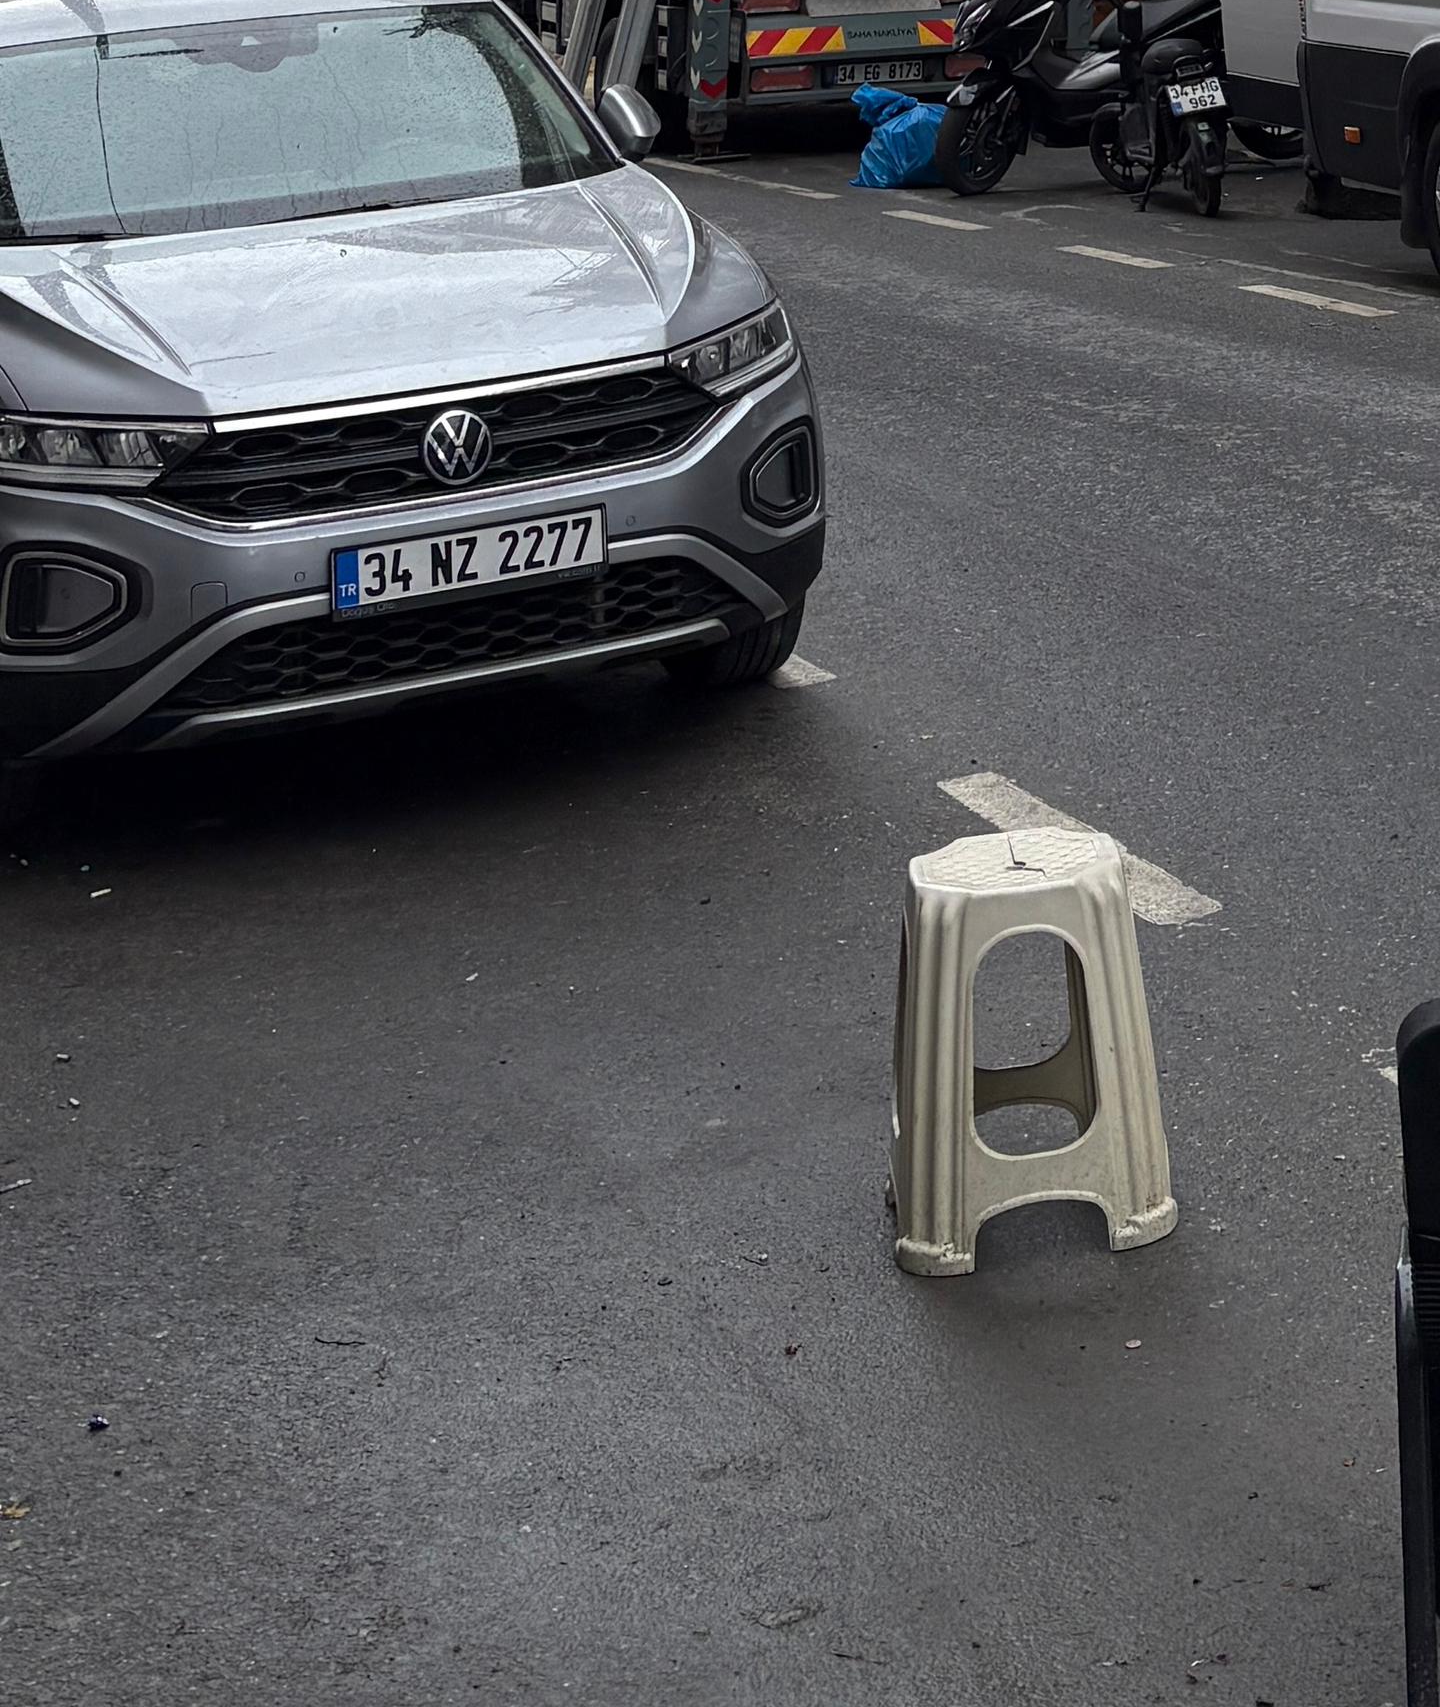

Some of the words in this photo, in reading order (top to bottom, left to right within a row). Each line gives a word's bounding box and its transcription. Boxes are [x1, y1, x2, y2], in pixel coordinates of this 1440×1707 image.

[839, 66, 855, 82] 34
[864, 64, 880, 80] EG
[888, 61, 921, 79] 8173
[1170, 87, 1189, 99] 34
[1189, 94, 1217, 108] 962
[338, 583, 357, 598] TR
[364, 548, 412, 597] 34
[430, 536, 478, 587] NZ
[498, 516, 593, 575] 2277
